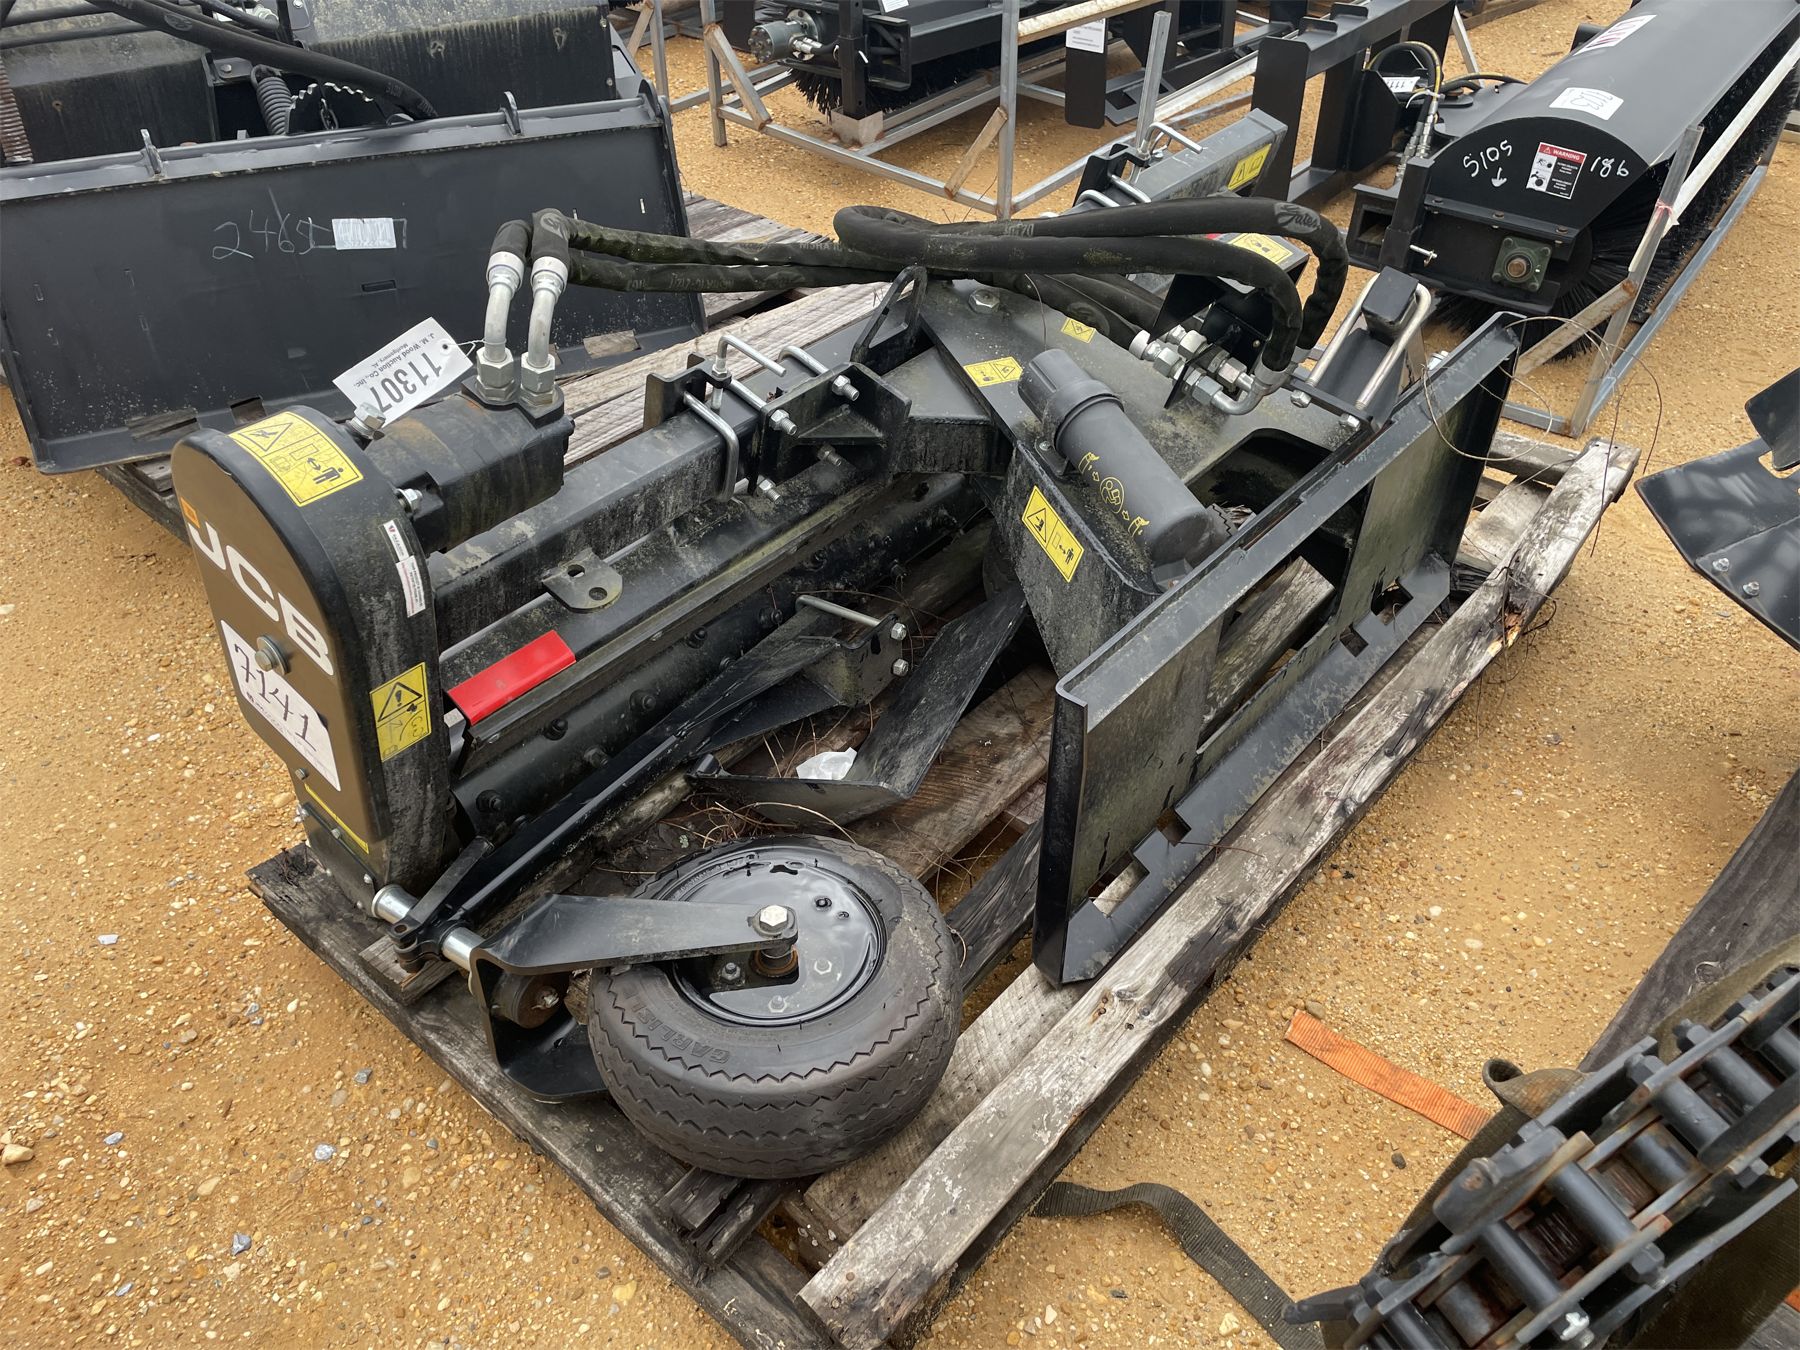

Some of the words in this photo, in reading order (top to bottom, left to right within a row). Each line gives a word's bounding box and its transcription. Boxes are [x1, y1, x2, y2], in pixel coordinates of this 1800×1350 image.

[1552, 149, 1580, 161] WARNING
[1590, 156, 1629, 178] 186
[402, 343, 420, 357] Wood
[378, 355, 402, 372] Auction
[370, 352, 442, 413] 11307
[187, 521, 334, 676] JCB
[234, 643, 317, 752] 7141
